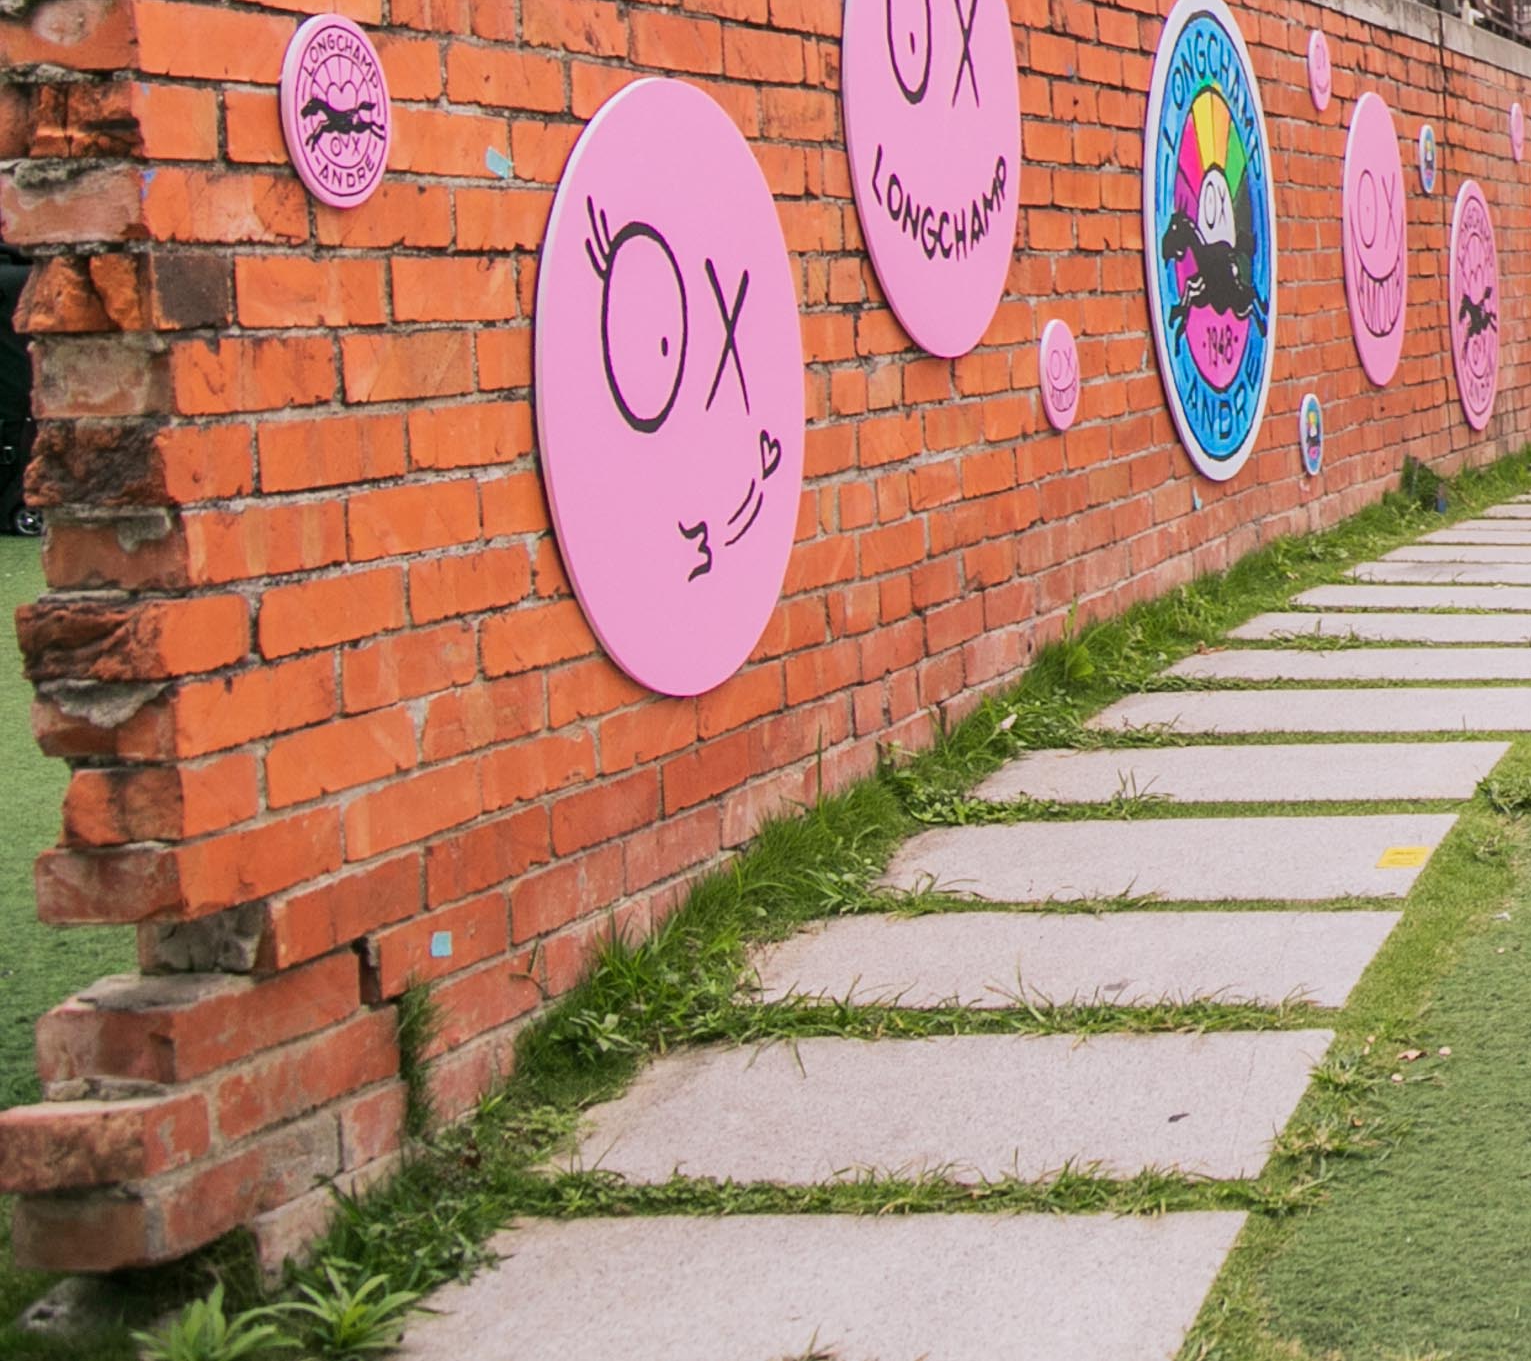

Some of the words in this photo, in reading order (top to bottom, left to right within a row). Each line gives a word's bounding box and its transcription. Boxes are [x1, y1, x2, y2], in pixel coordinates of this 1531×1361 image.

[303, 33, 380, 90] LONGCHAMP
[1162, 29, 1262, 181] LONGCHAMP
[318, 157, 376, 189] ANDRE
[871, 142, 1007, 262] LONGCHAMP
